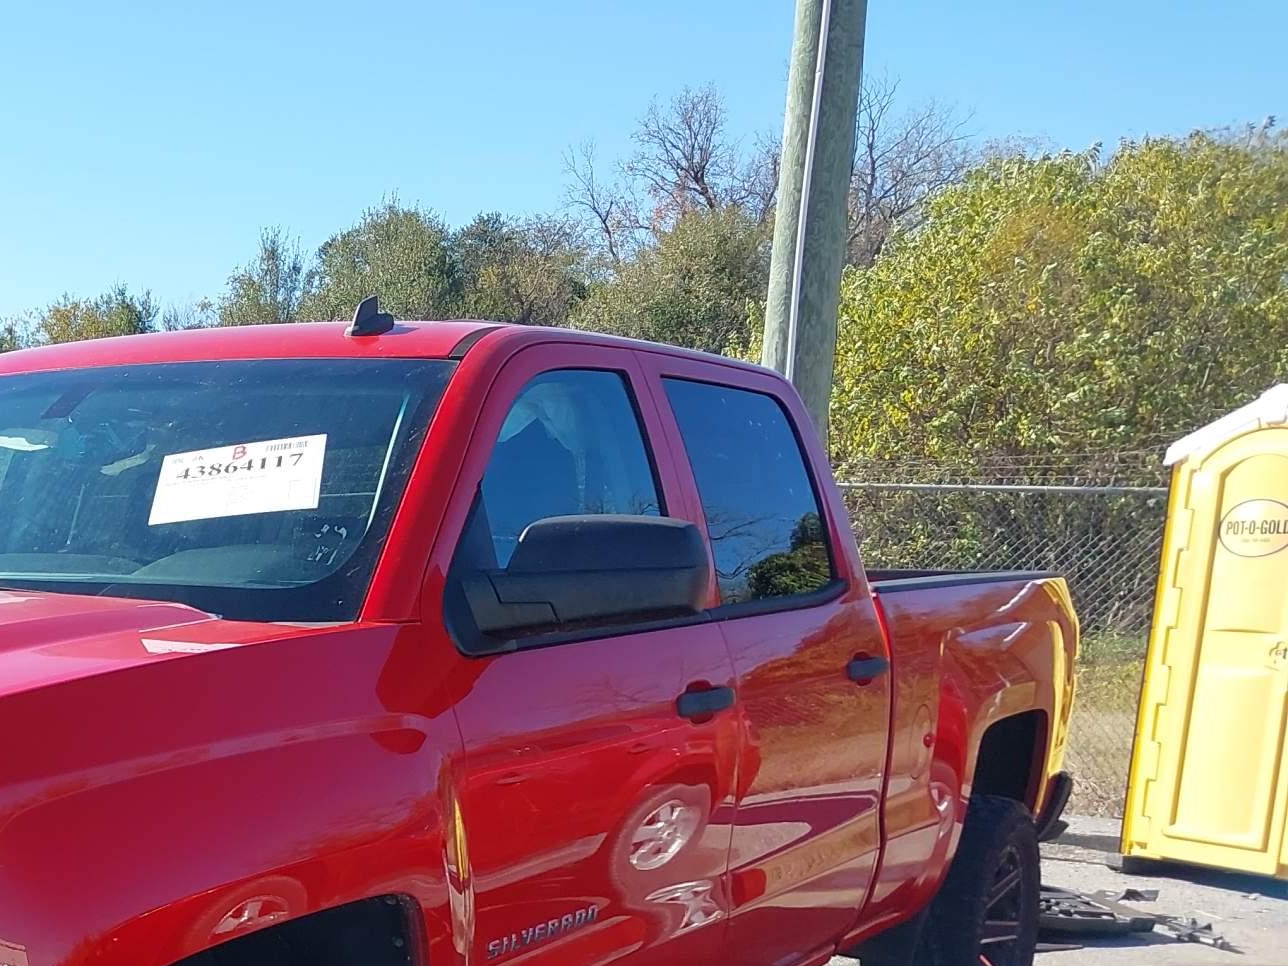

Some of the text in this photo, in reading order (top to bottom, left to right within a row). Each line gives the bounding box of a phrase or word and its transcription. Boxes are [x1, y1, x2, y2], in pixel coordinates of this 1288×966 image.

[176, 452, 304, 480] 43864117
[232, 445, 247, 460] B
[487, 904, 600, 960] SILVERADO
